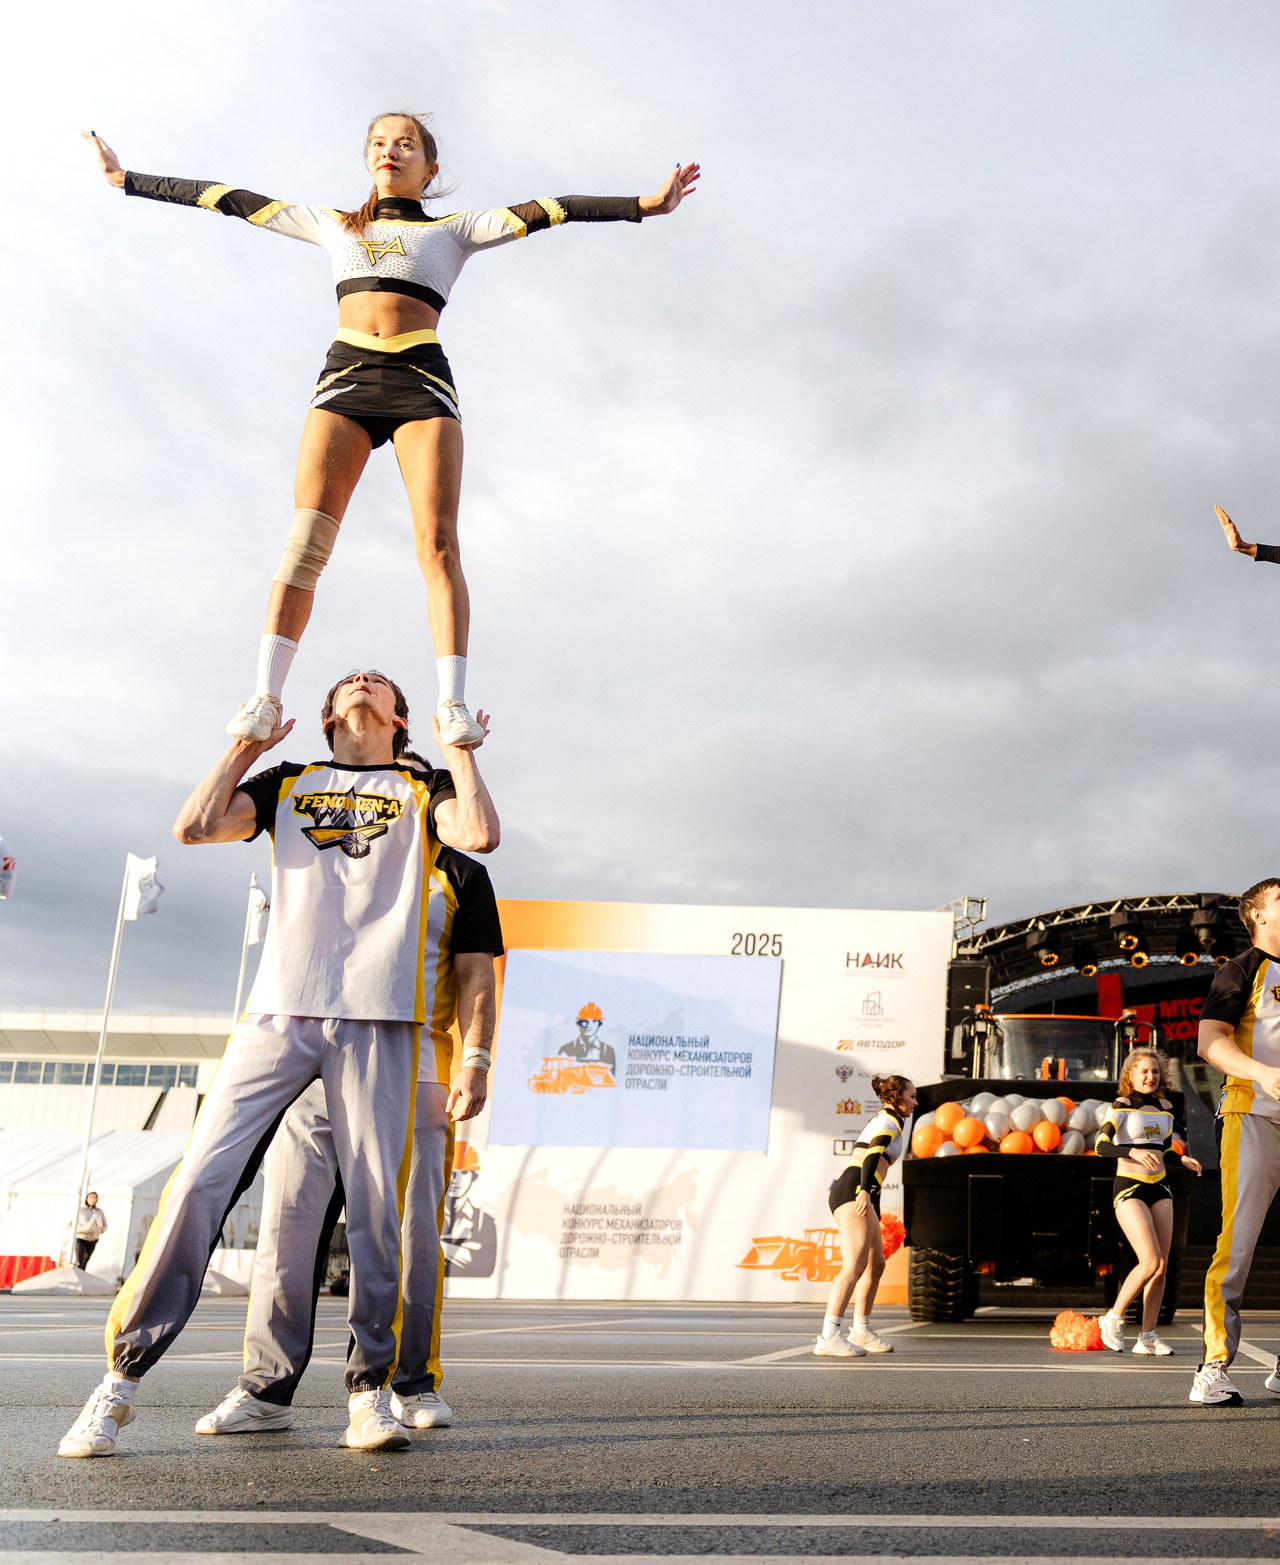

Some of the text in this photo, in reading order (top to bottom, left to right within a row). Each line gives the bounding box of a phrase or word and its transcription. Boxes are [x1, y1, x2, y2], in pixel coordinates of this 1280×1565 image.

[299, 795, 400, 815] FENOMEN-A
[731, 932, 782, 957] 2025
[846, 952, 904, 969] НАИК
[1160, 998, 1203, 1018] МТС
[628, 1034, 709, 1048] НАЦИОНАЛЬНЫЙ
[856, 1040, 906, 1049] АВТОДОР
[627, 1049, 753, 1064] КОНКУРС МЕХАНИЗАТОРОВ
[625, 1064, 752, 1078] ДОРОЖНО-СТРОИТЕЛЬНОЙ
[625, 1078, 667, 1090] ОТРАСЛИ
[563, 1203, 642, 1216] НАЦИОНАЛЬНЫЙ
[562, 1218, 683, 1231] КОНКУРС МЕХАНИЗАТОРОВ
[560, 1232, 682, 1245] ДОРОЖНО-СТРОИТЕЛЬНОЙ
[559, 1247, 599, 1258] ОТРАСЛИ
